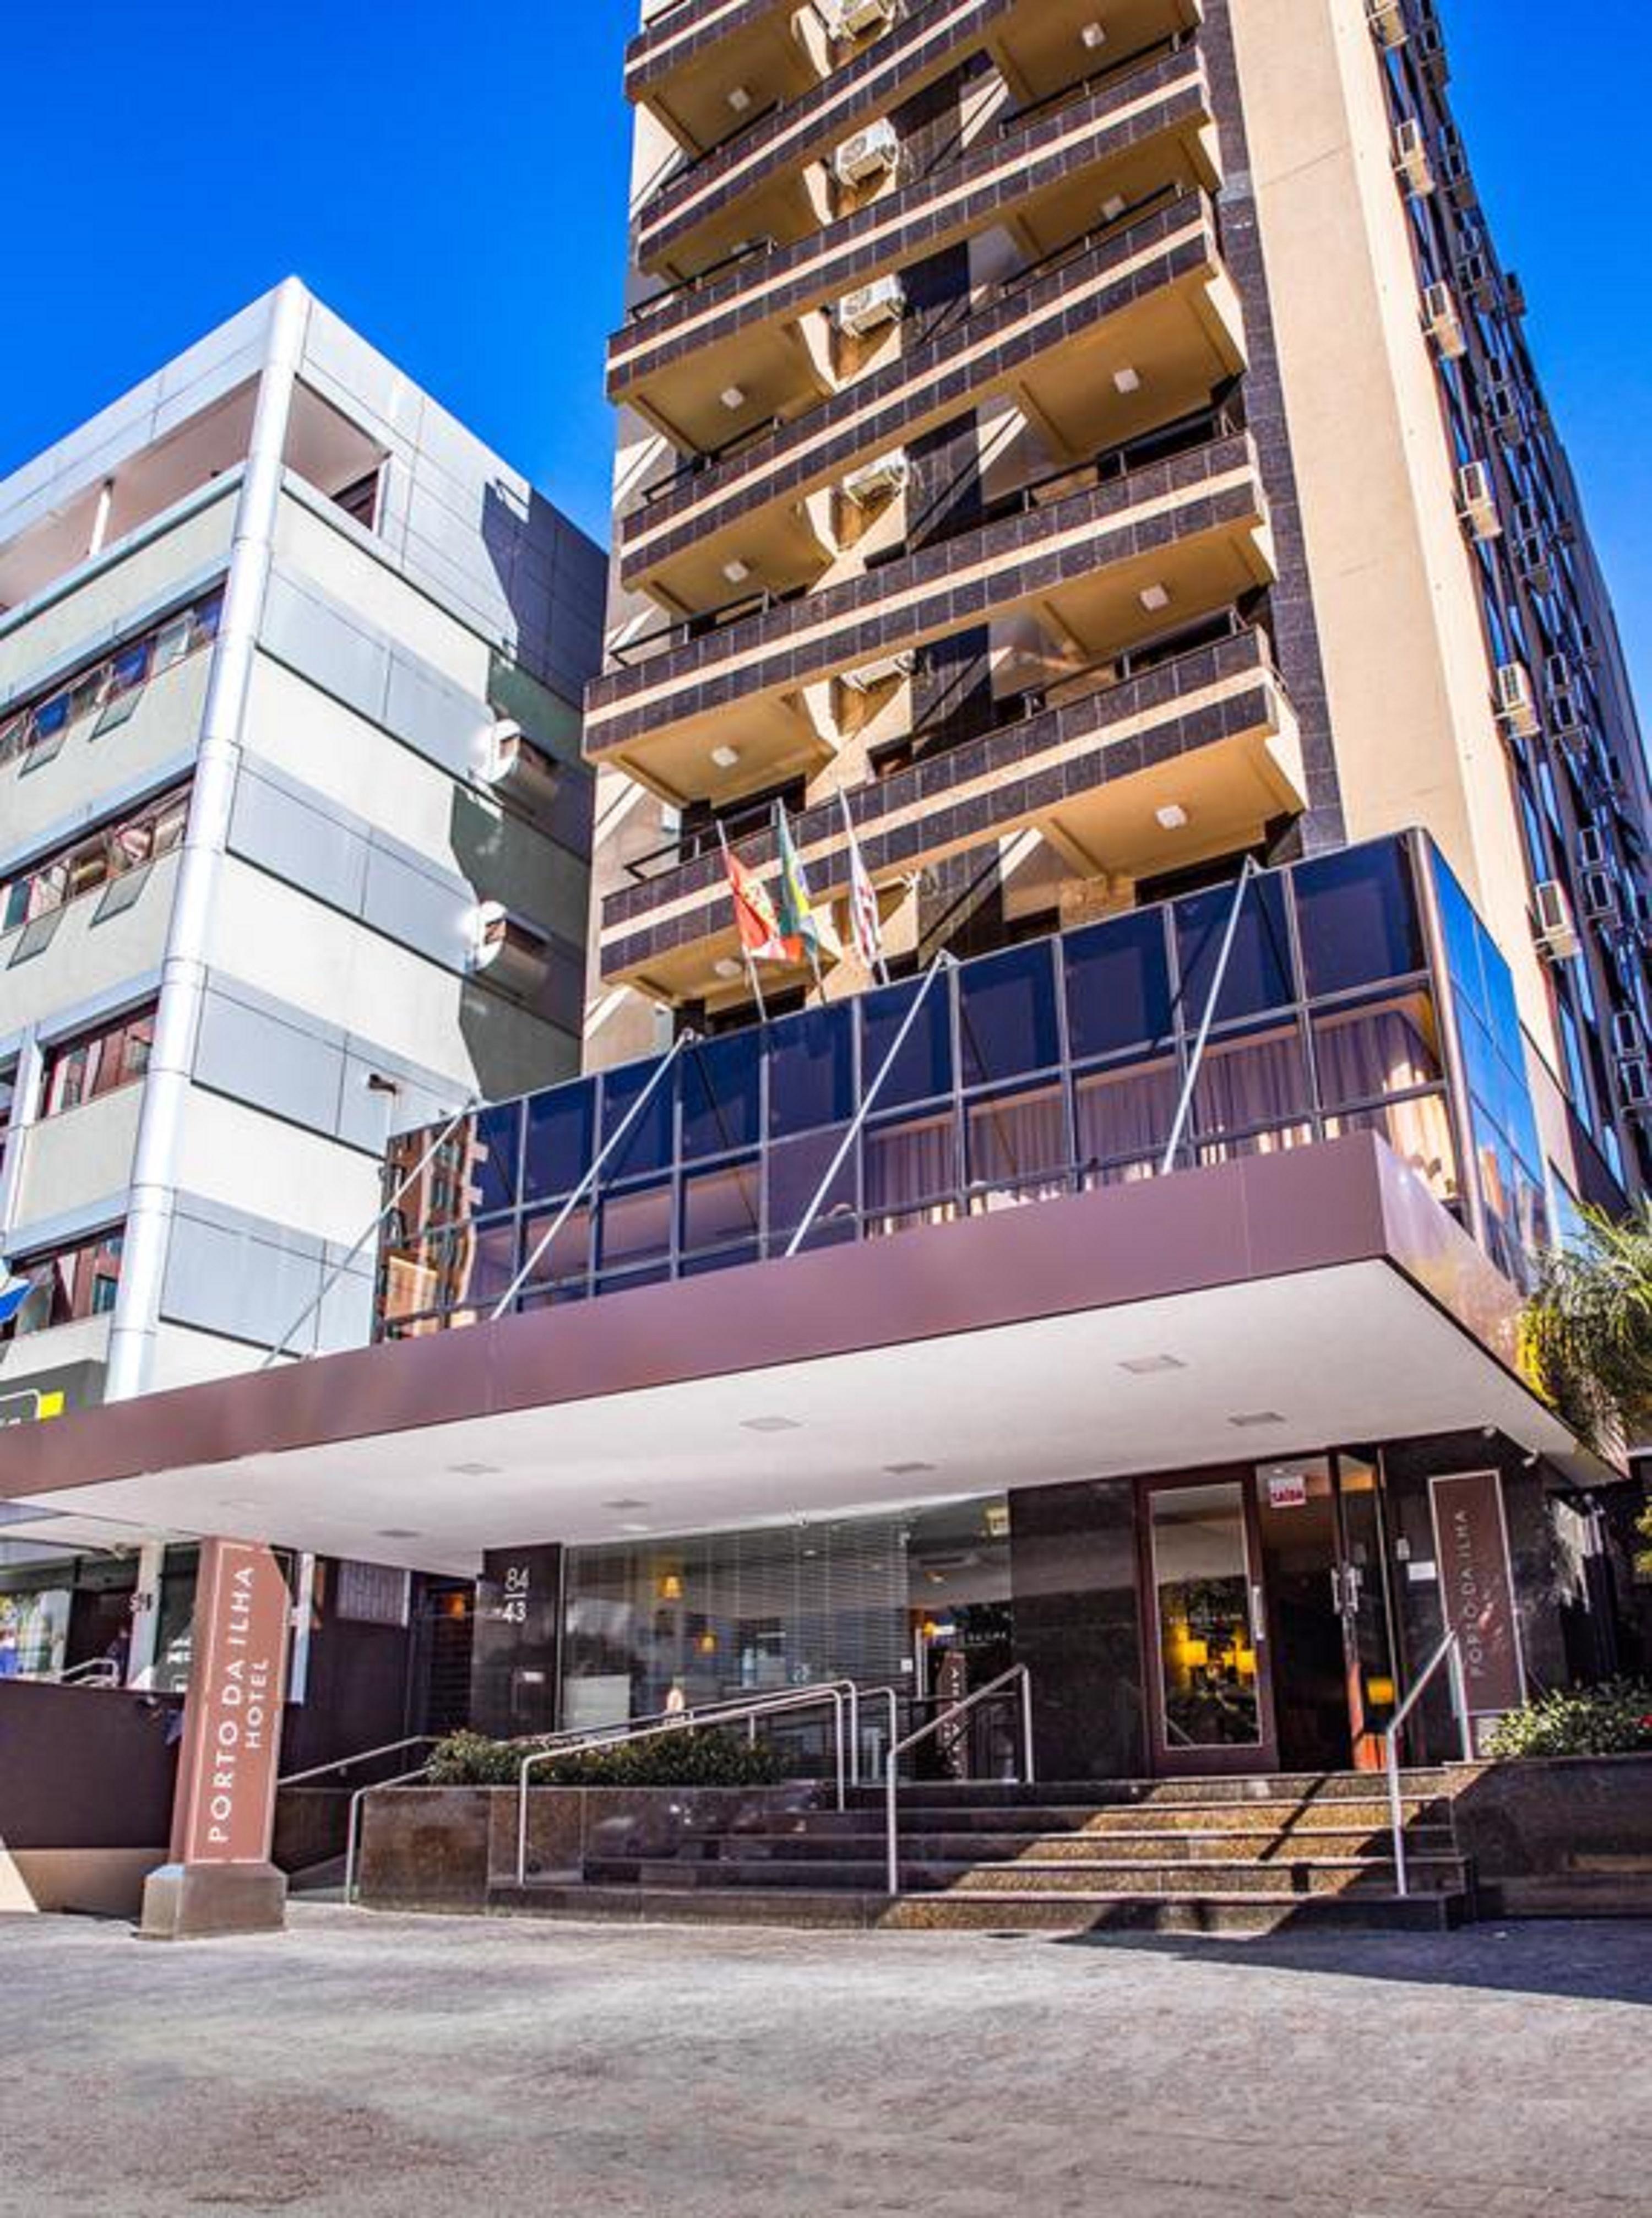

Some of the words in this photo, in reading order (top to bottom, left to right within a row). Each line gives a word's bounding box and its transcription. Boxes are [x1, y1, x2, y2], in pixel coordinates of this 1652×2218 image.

[1454, 1510, 1471, 1558] ILHA
[505, 1565, 529, 1592] 84
[1460, 1568, 1476, 1596] DA
[227, 1567, 254, 1645] ILHA
[502, 1601, 526, 1623] 43
[1463, 1602, 1485, 1677] PORTO
[221, 1660, 244, 1705] DA
[244, 1658, 269, 1748] HOTEL
[207, 1720, 238, 1842] PORTO
